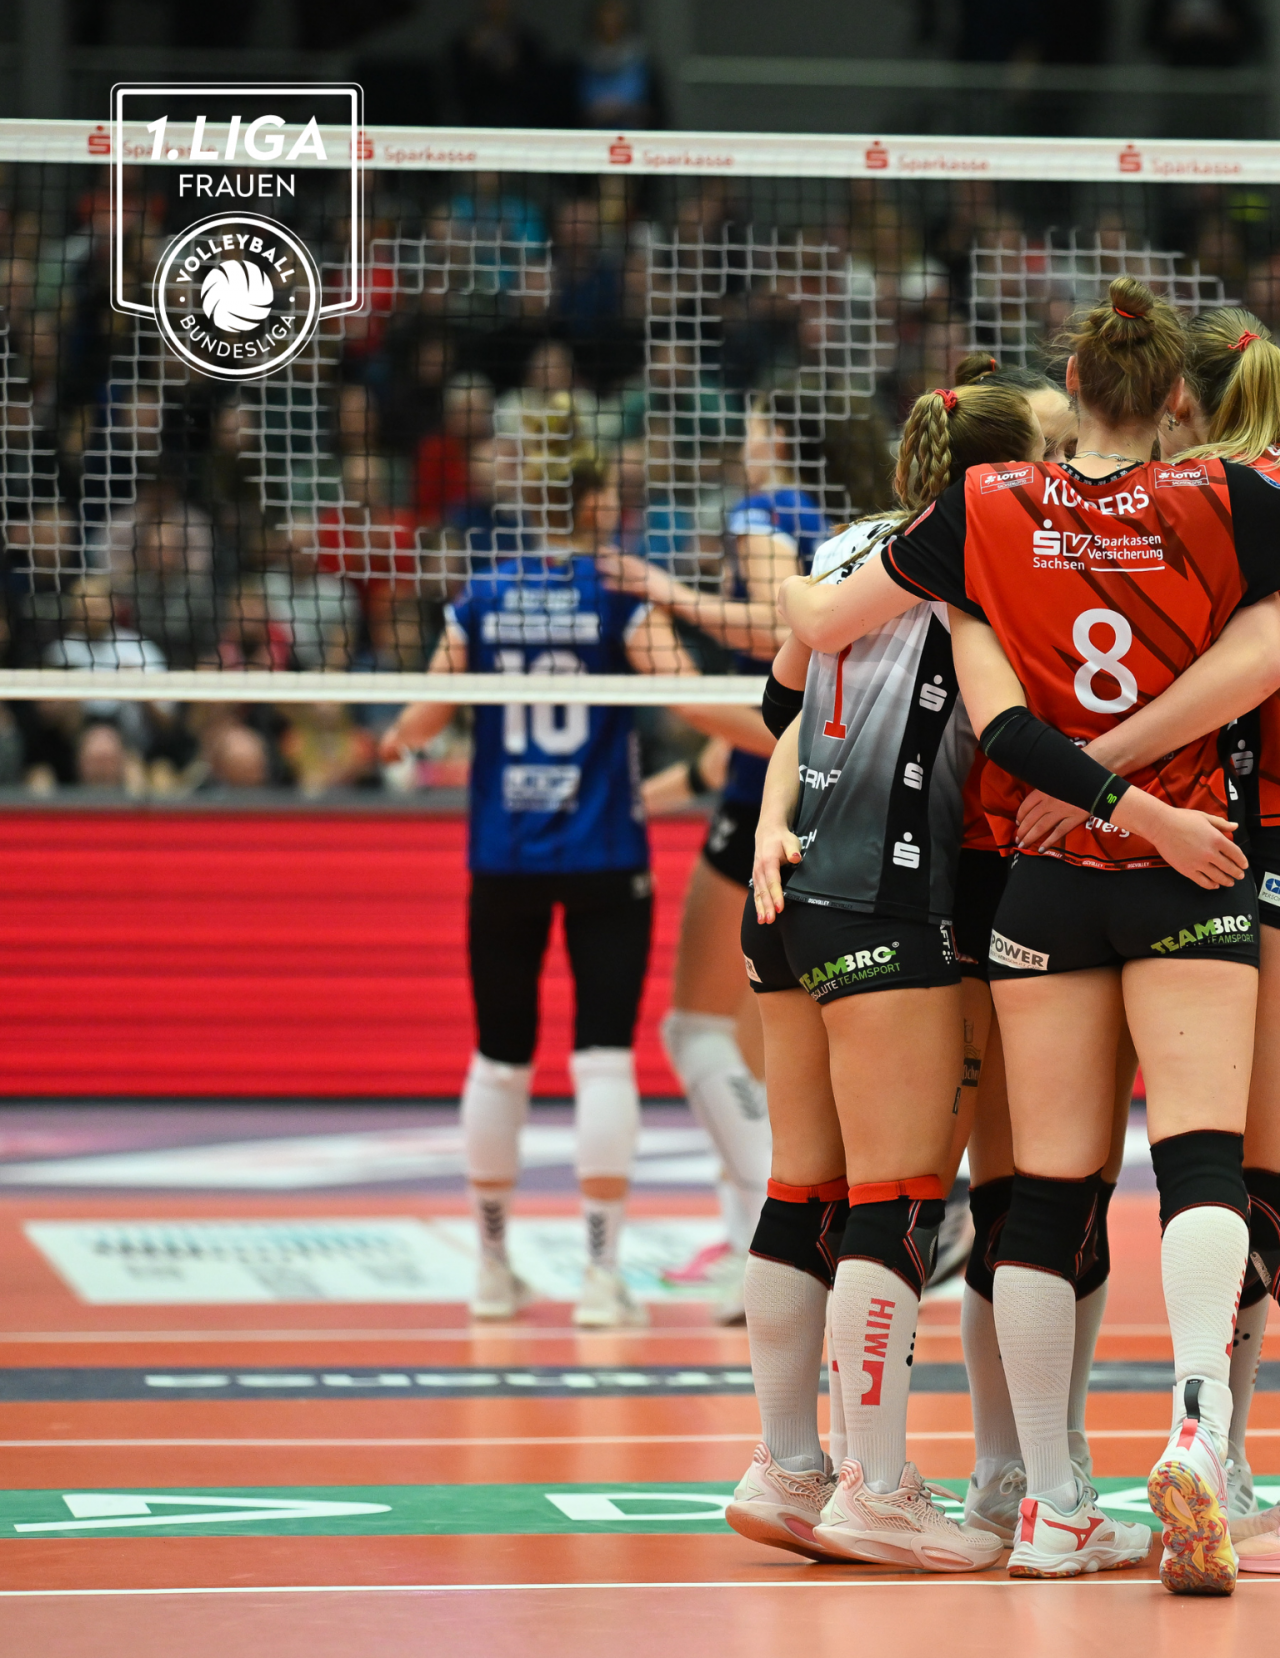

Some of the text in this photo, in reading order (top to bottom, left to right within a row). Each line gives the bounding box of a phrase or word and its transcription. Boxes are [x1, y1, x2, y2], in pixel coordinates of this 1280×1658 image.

[997, 469, 1029, 481] LOTTO
[1170, 469, 1202, 479] LOTTO
[1094, 534, 1162, 549] Sparkassen
[1087, 548, 1164, 561] Versicherung
[1033, 556, 1085, 571] Sachsen
[1072, 608, 1138, 714] 8
[1207, 933, 1255, 944] TEAMSPORT
[839, 962, 901, 986] TEAMSPORT
